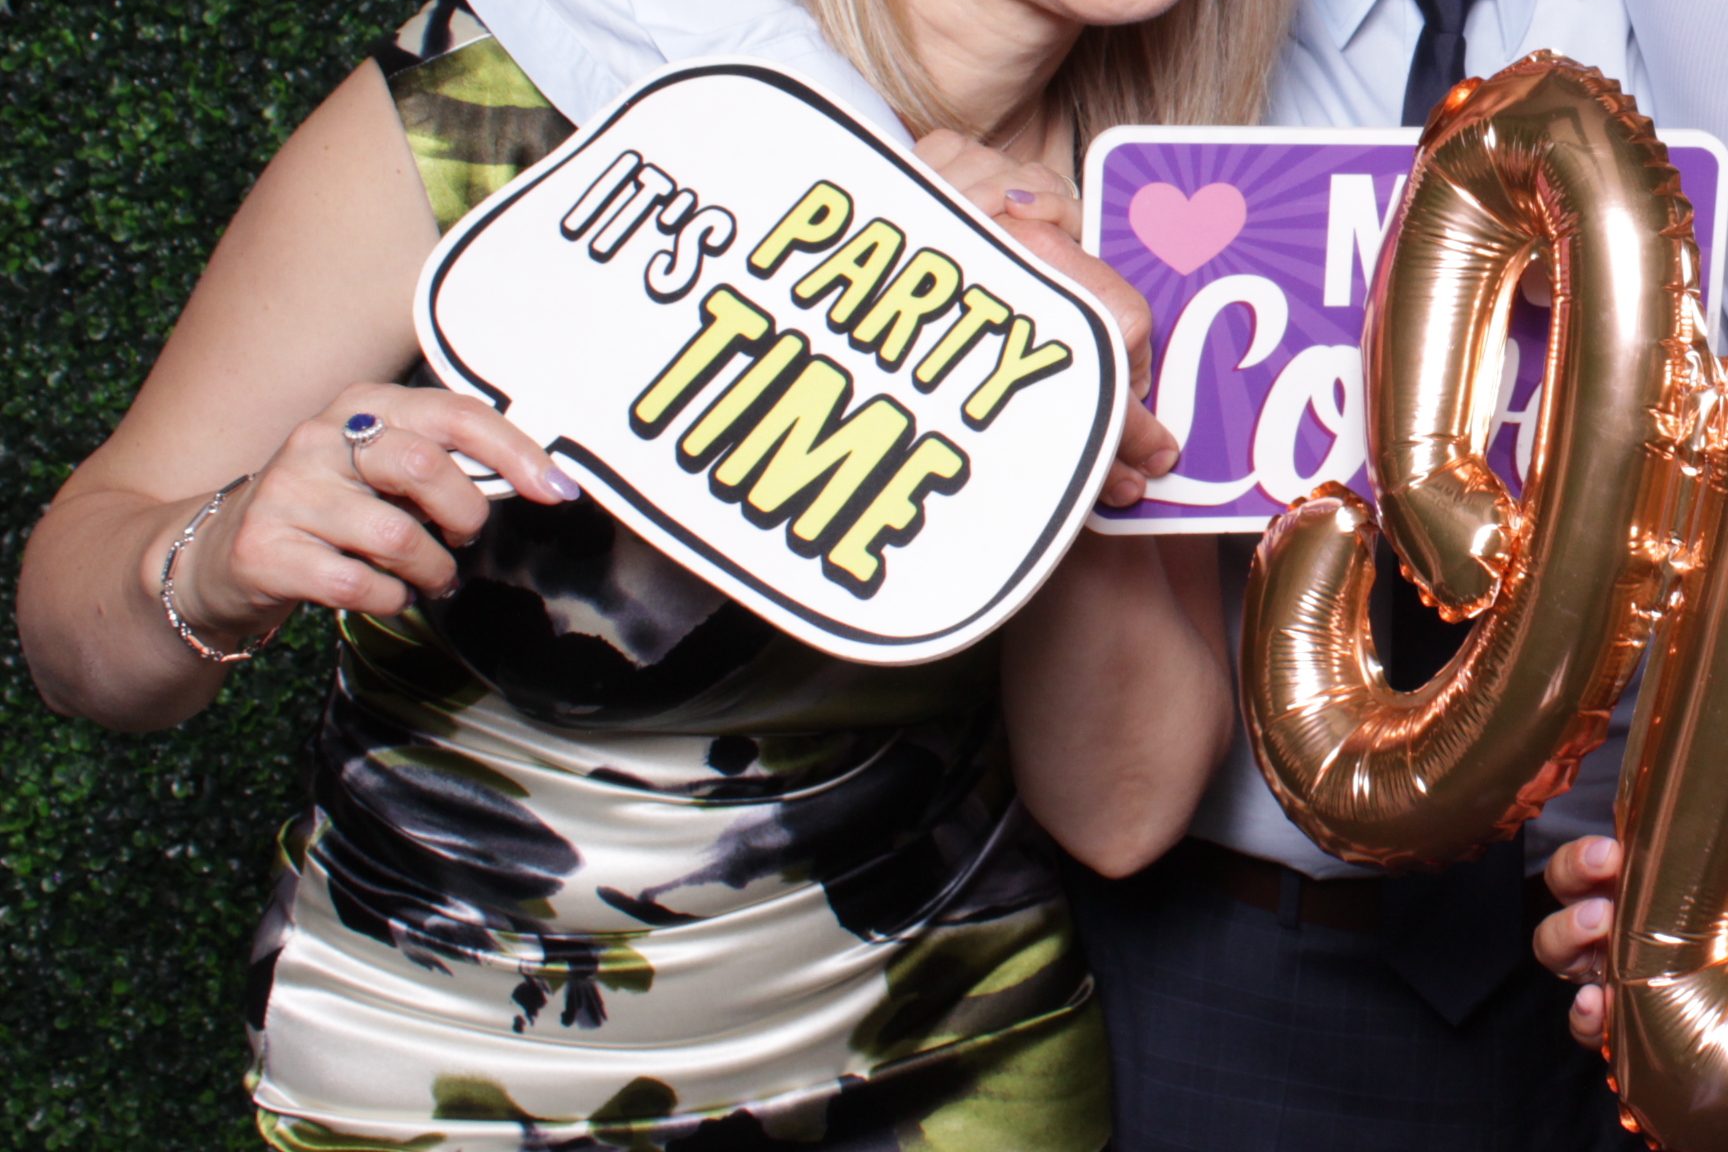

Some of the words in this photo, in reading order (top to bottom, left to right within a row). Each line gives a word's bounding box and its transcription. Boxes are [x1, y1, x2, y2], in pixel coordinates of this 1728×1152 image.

[560, 149, 737, 304] IT'S
[746, 179, 1073, 432] PARTY
[628, 283, 971, 601] TIME
